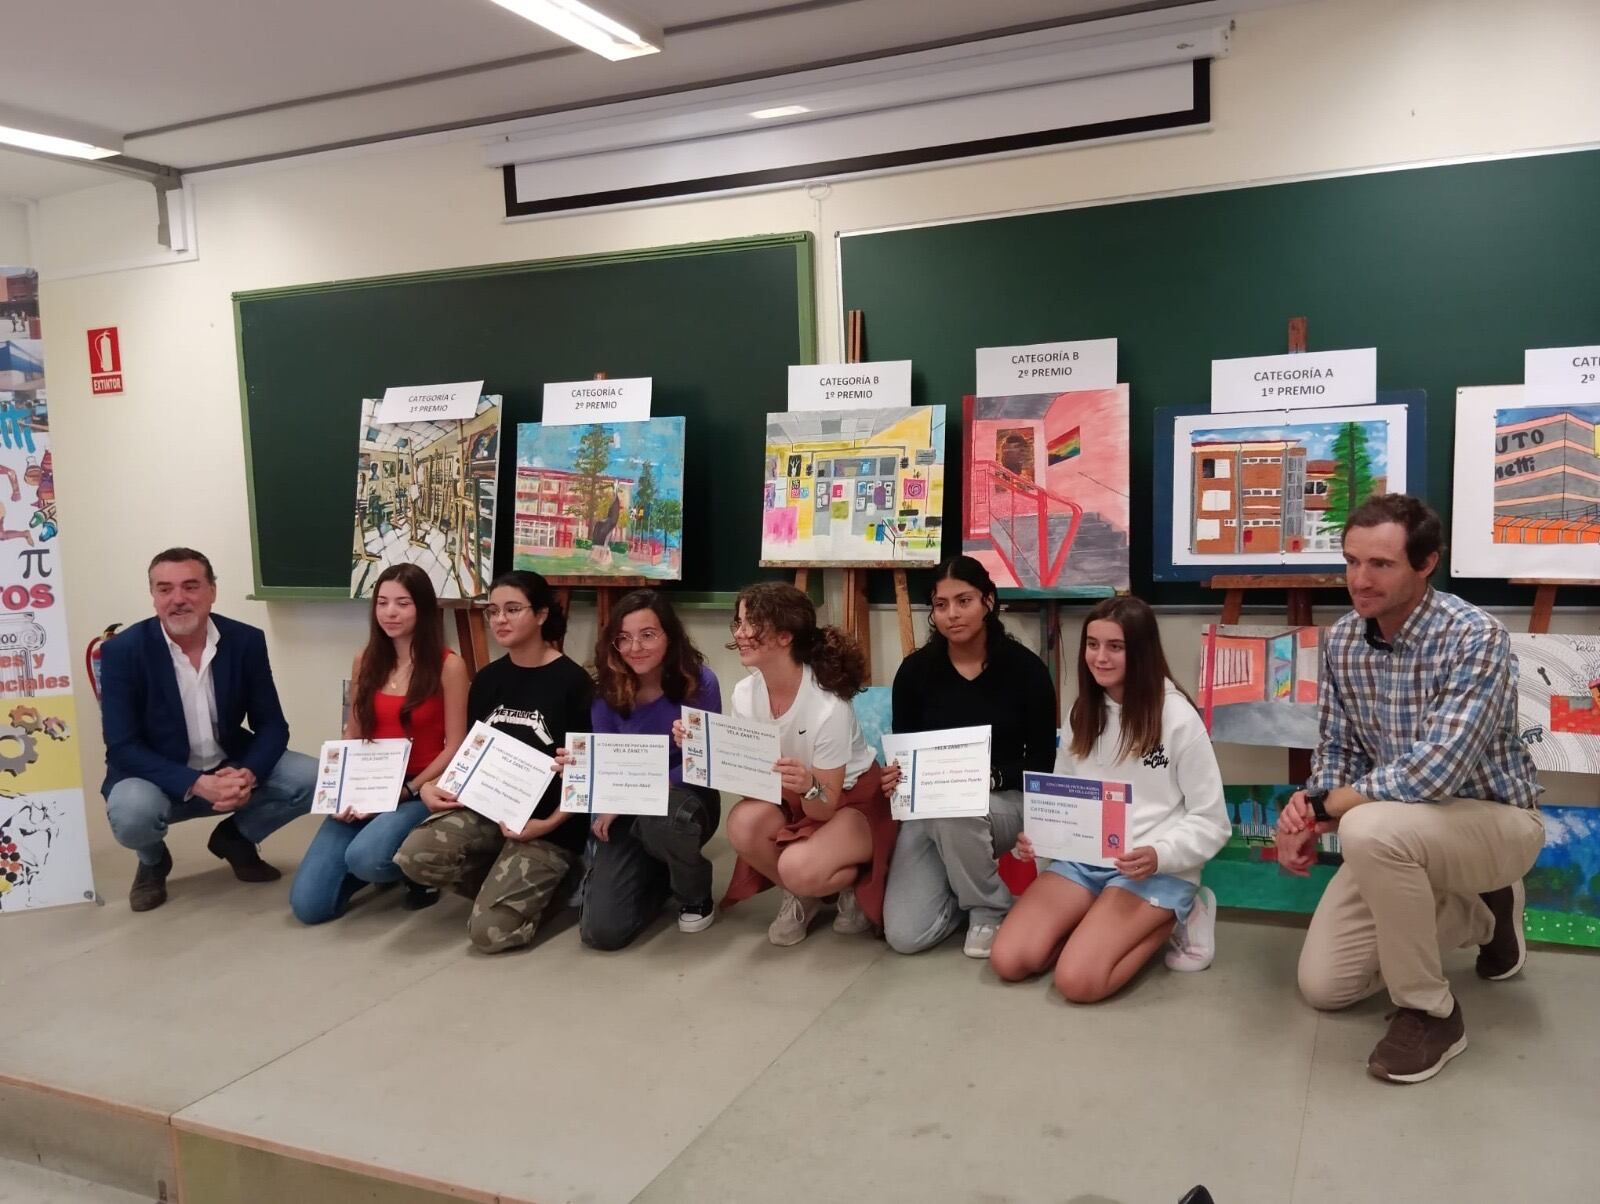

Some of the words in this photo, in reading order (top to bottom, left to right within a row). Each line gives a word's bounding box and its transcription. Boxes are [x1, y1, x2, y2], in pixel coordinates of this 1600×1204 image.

[1011, 350, 1070, 364] CATEGORÍA
[1072, 351, 1080, 360] B
[1572, 356, 1600, 368] CAT
[1017, 369, 1029, 378] 2º
[1031, 367, 1073, 378] PREMIO
[1253, 367, 1322, 382] CATEGORÍA
[1325, 368, 1334, 378] A
[93, 379, 122, 391] EXTINTOR
[819, 375, 871, 386] CATEGORÍA
[873, 376, 880, 384] B
[571, 386, 616, 398] CATEGORÍA
[618, 388, 623, 396] C
[825, 391, 835, 400] 1º
[837, 390, 873, 399] PREMIO
[1261, 387, 1274, 397] 1º
[1277, 385, 1325, 396] PREMIO
[419, 404, 448, 413] PREMIO
[586, 401, 617, 410] PREMIO
[0, 583, 55, 611] OS
[32, 653, 45, 669] y
